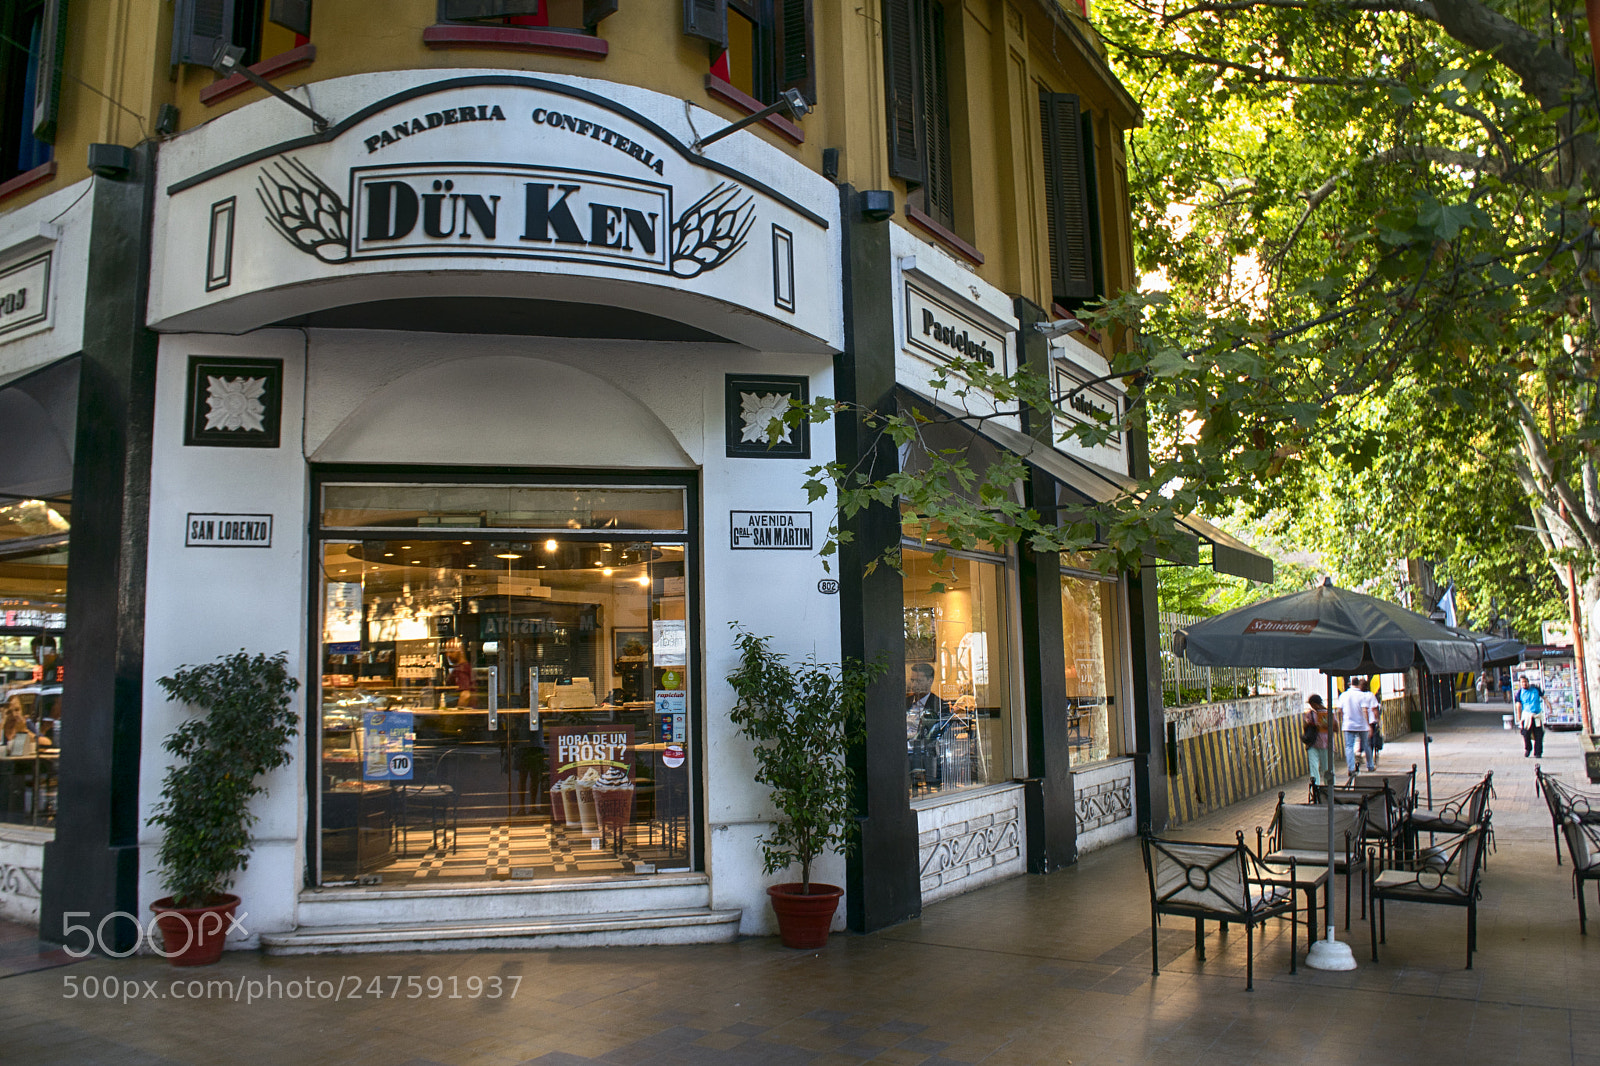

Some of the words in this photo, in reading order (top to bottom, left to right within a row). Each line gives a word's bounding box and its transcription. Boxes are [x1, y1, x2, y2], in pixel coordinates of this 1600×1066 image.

[363, 104, 506, 154] PANADERIA
[532, 107, 664, 176] CONFITERIA
[519, 182, 659, 255] KEN
[191, 520, 215, 540] SAN
[218, 520, 268, 541] LORENZO
[748, 515, 794, 527] AVENIDA
[753, 527, 772, 546] SAN
[774, 527, 810, 546] MARTIN
[821, 581, 837, 591] 802
[1251, 620, 1313, 632] Schneider
[558, 735, 590, 746] HORA
[593, 734, 607, 745] DE
[610, 733, 627, 744] UN
[558, 743, 627, 763] FROST?
